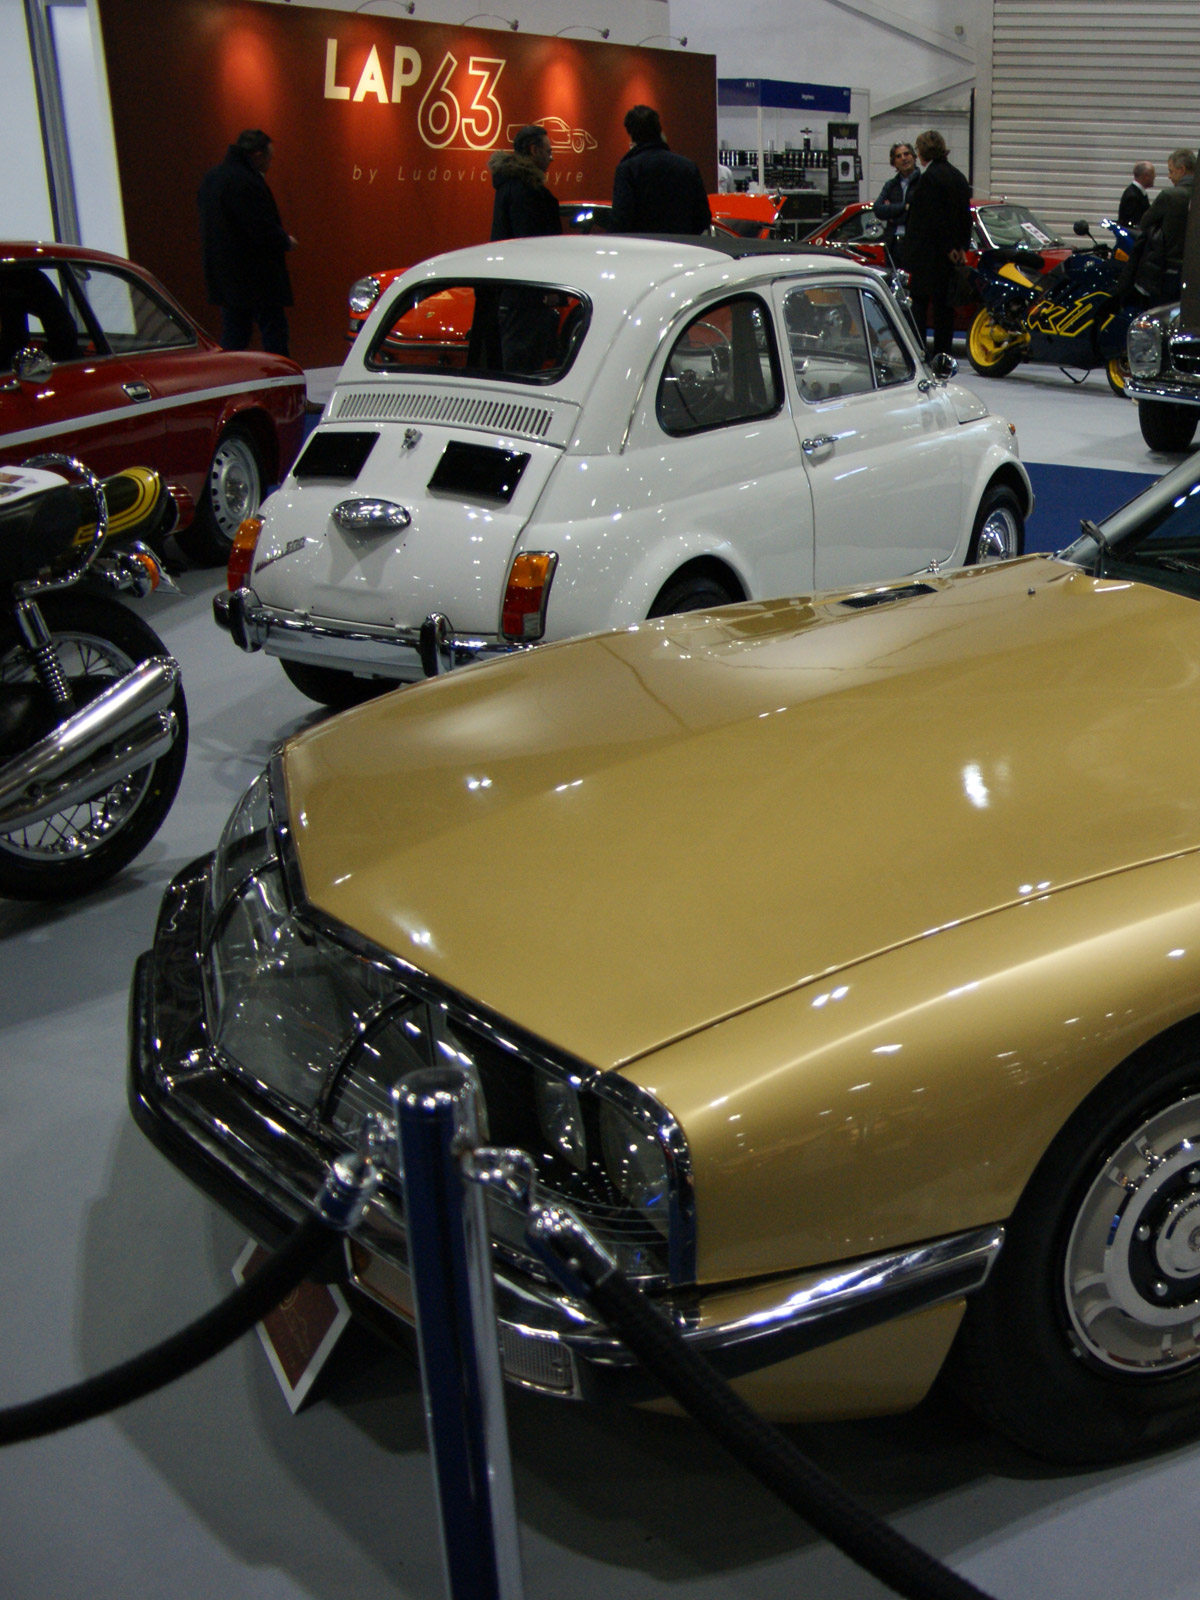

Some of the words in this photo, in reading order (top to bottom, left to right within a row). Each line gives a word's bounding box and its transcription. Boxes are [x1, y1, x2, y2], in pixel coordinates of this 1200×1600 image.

[324, 38, 422, 104] LAP
[417, 51, 506, 150] 63
[352, 164, 378, 184] by
[398, 165, 488, 182] Ludovic
[543, 171, 584, 186] ayre
